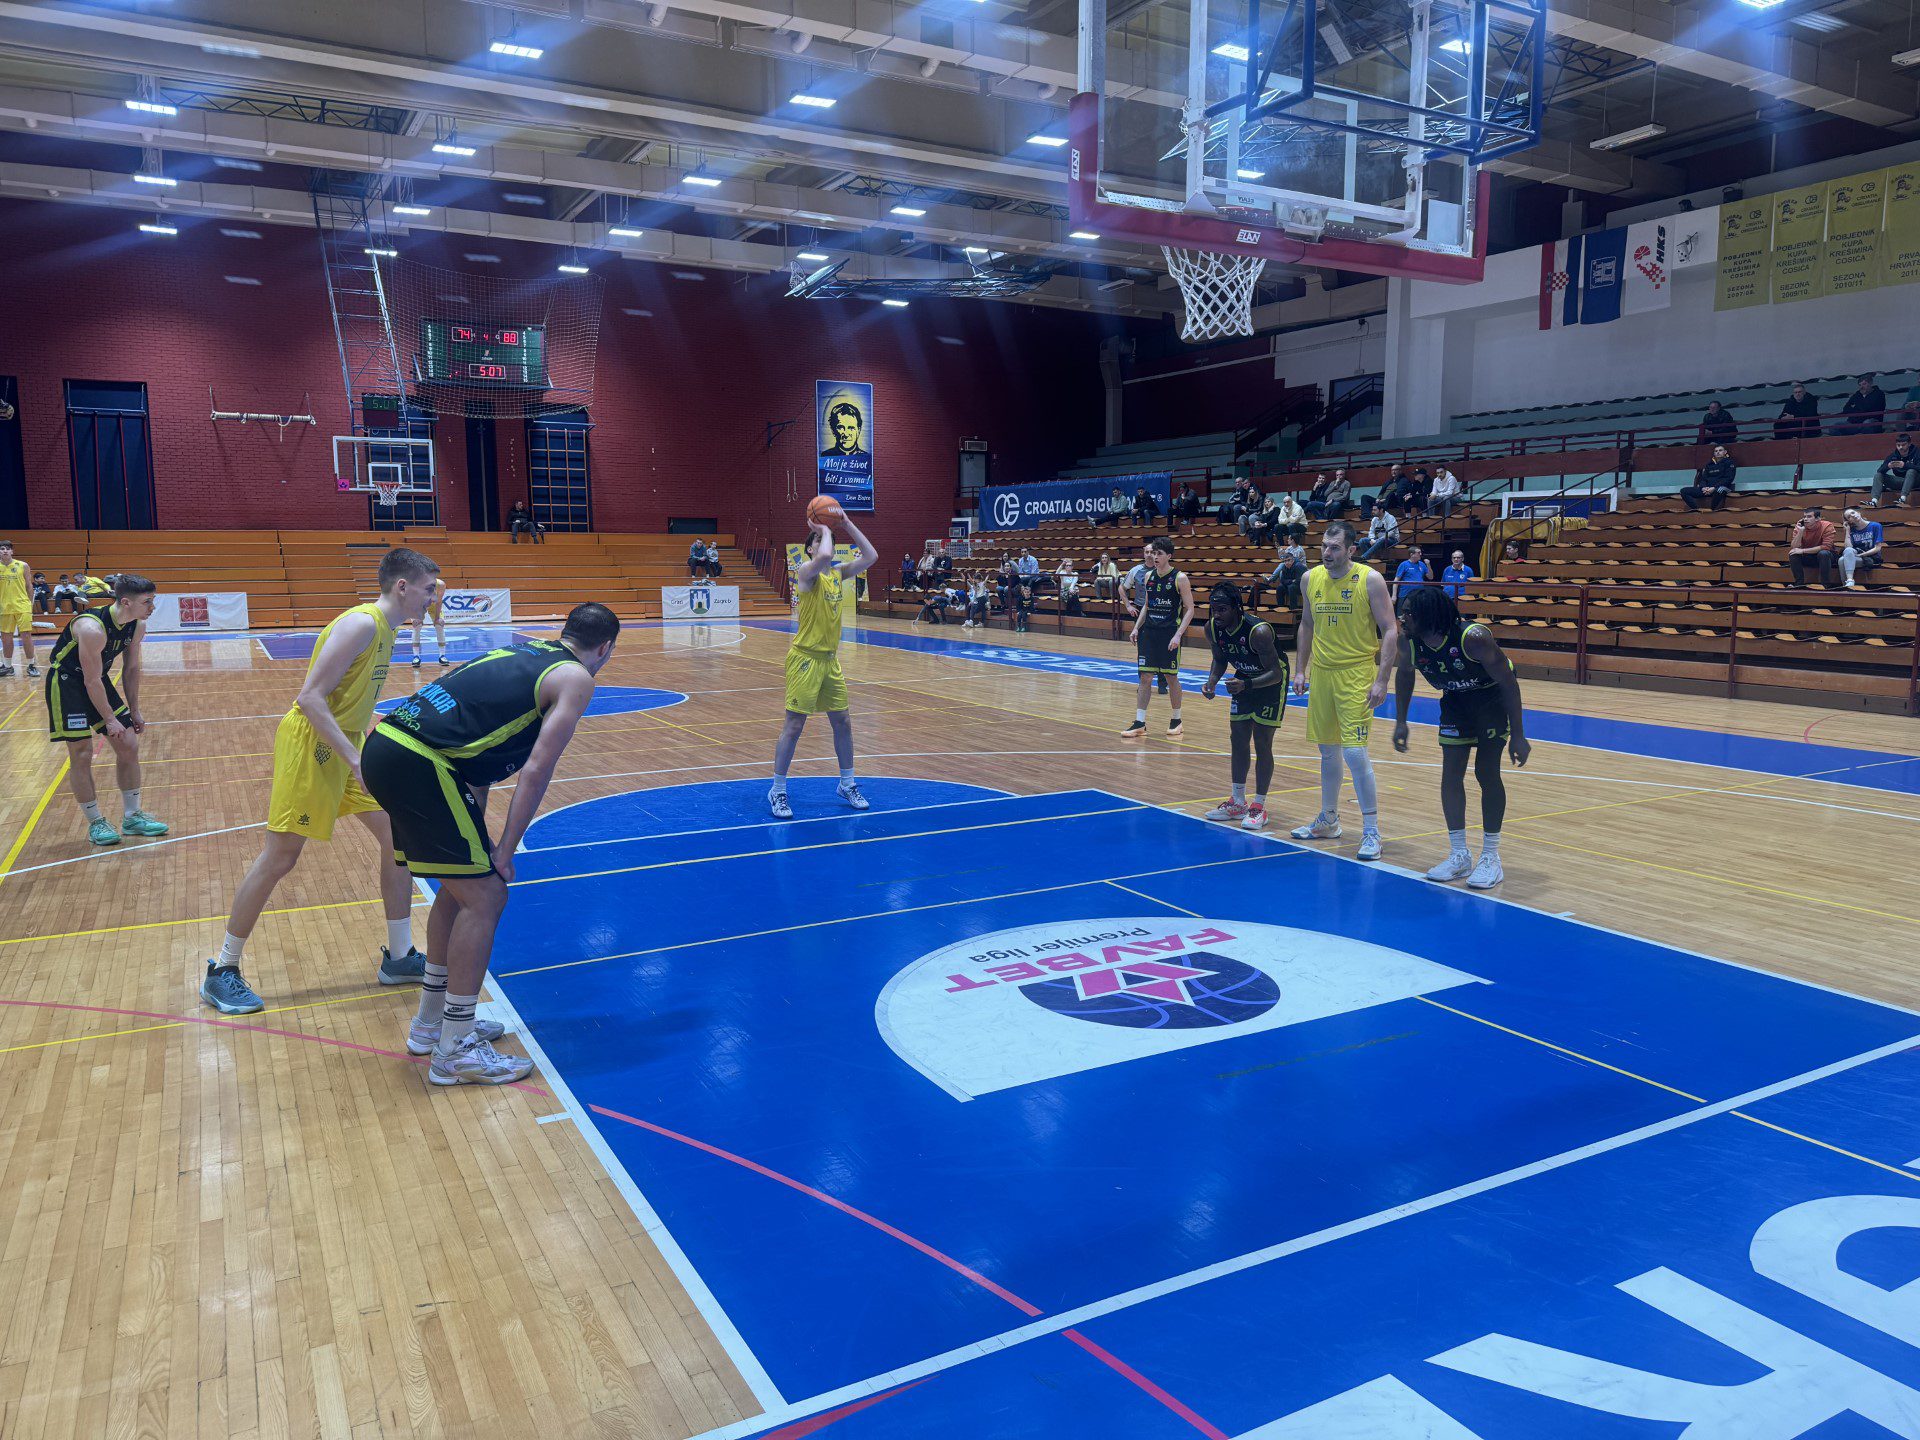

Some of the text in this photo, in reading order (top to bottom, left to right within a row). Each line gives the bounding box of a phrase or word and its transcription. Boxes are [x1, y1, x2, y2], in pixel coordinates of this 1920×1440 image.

[1237, 229, 1261, 244] ELAN
[1830, 228, 1875, 241] POBJEDNIK
[1656, 225, 1666, 263] HKS
[1776, 239, 1818, 252] POBJEDNIK
[1841, 240, 1864, 248] KUPA
[1723, 250, 1763, 261] POBJEDNIK
[1787, 250, 1808, 258] KUPA
[1833, 272, 1866, 282] SEZONA
[1727, 284, 1754, 292] SEZONA
[1780, 281, 1810, 291] SEZONA
[458, 329, 470, 339] 74
[503, 333, 516, 343] 88
[1024, 500, 1073, 515] CROATIA
[1328, 615, 1338, 626] 14
[1228, 643, 1239, 654] 21
[1437, 661, 1448, 673] 2
[1261, 706, 1274, 718] 21
[1357, 725, 1368, 741] 14
[968, 927, 1152, 963] Premijer liga
[944, 927, 1238, 994] FAVBET
